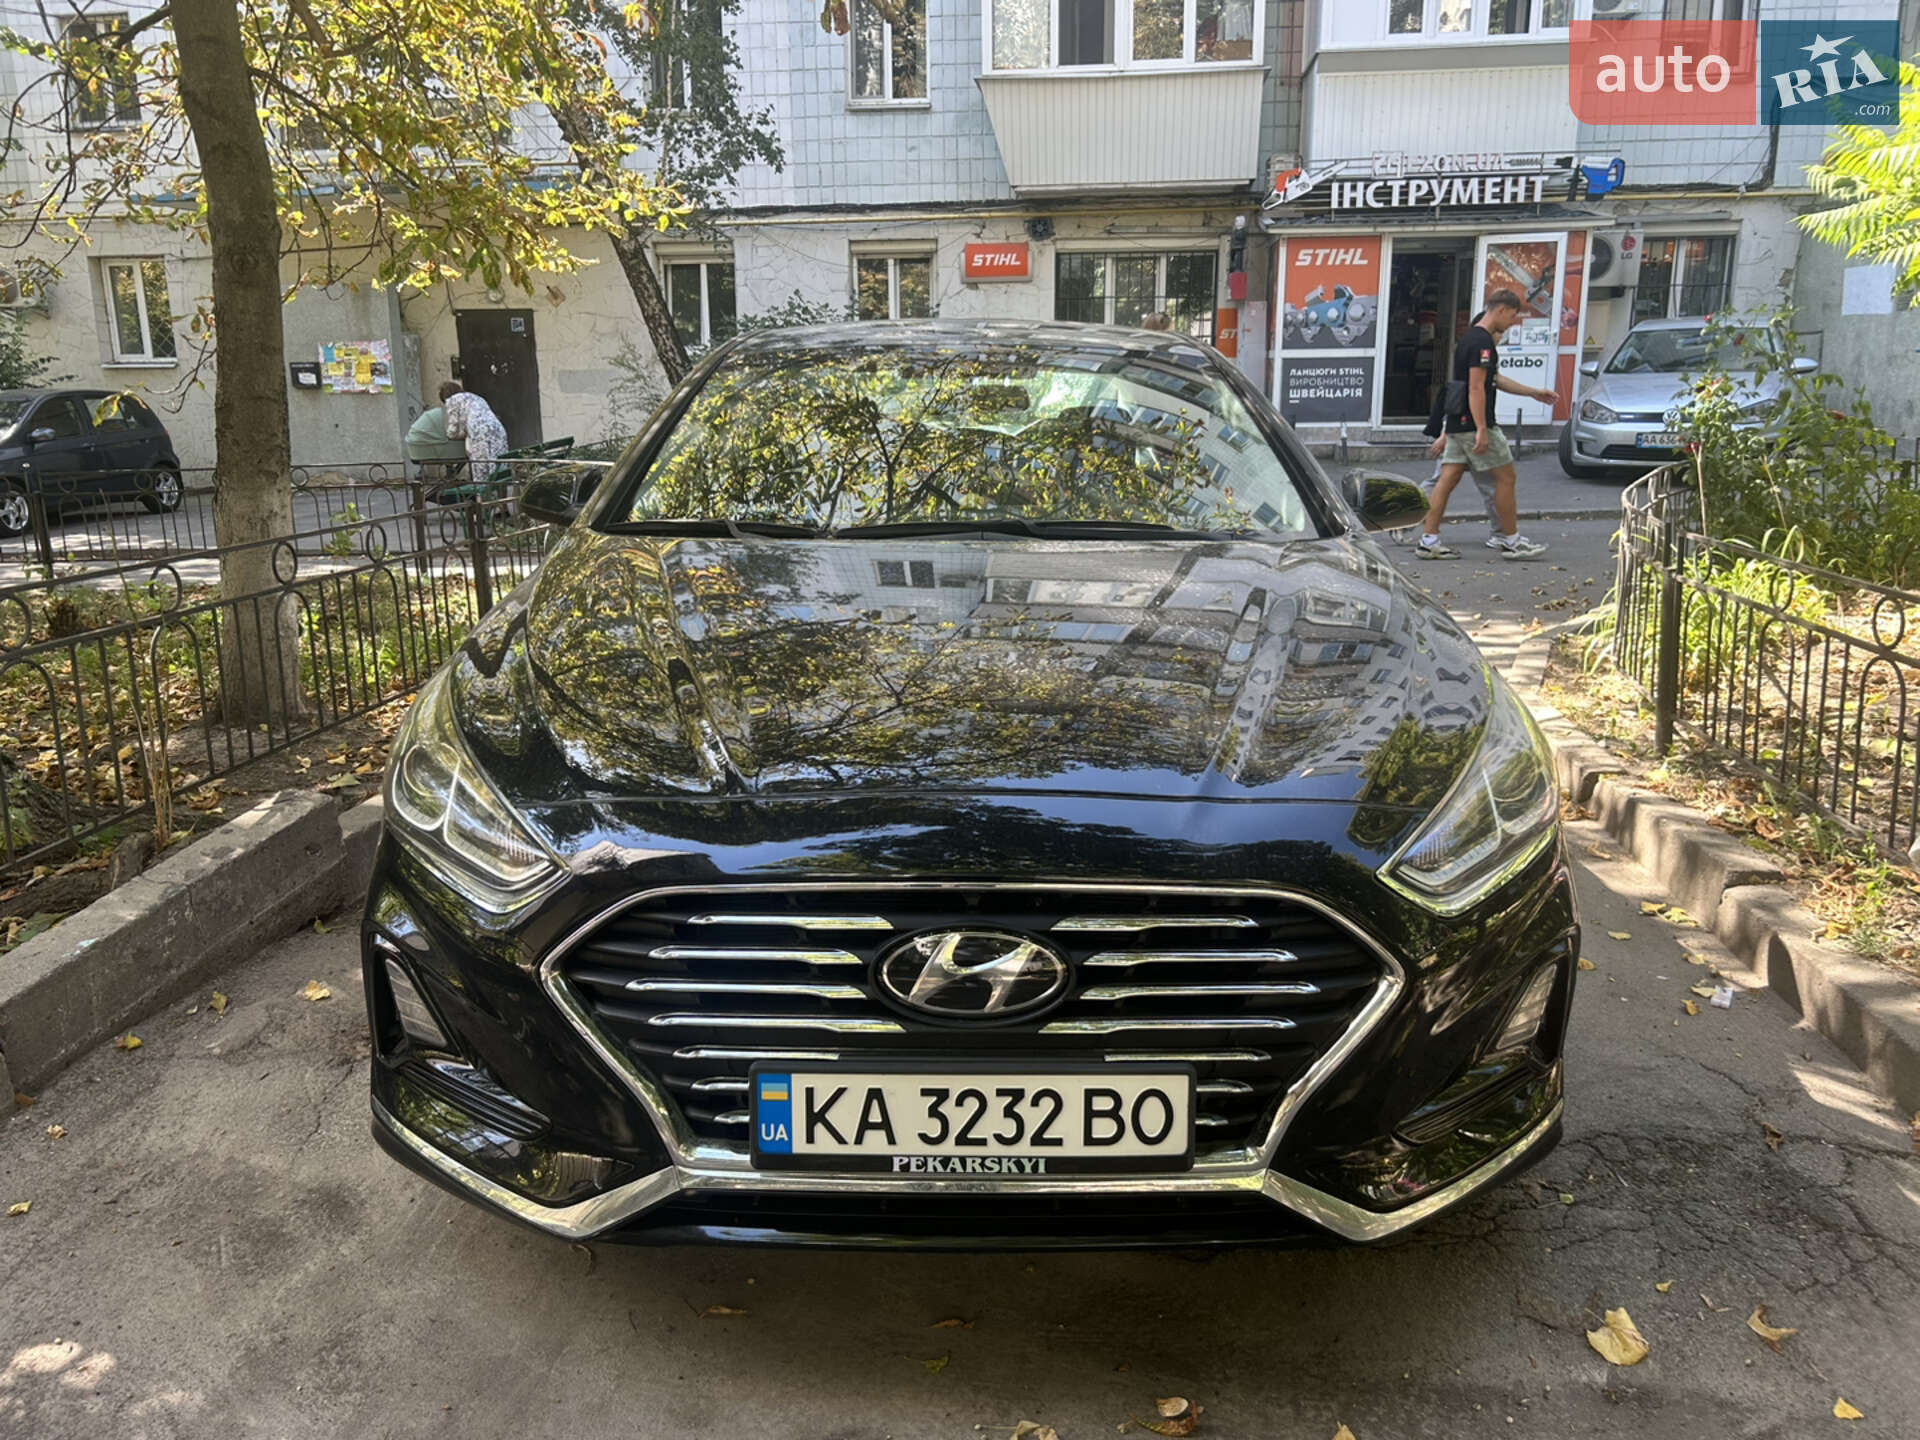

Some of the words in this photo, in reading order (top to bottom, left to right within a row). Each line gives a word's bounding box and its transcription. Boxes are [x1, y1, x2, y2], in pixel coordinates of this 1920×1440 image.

[1330, 175, 1549, 209] ІНСТРУМЕНТ
[971, 253, 1021, 267] STIHL
[1295, 247, 1369, 266] STIHL
[1500, 357, 1543, 368] etabo
[1289, 368, 1337, 376] ЛАНЦЮГИ
[1290, 377, 1365, 386] ВИРОБНИЦТВО
[1289, 386, 1363, 398] ШВЕЙЦАРІЯ
[805, 1087, 896, 1145] KA
[918, 1088, 1063, 1146] 3232
[1083, 1088, 1174, 1145] BO
[761, 1124, 789, 1141] UA
[892, 1156, 1047, 1173] PEKARSKYI
